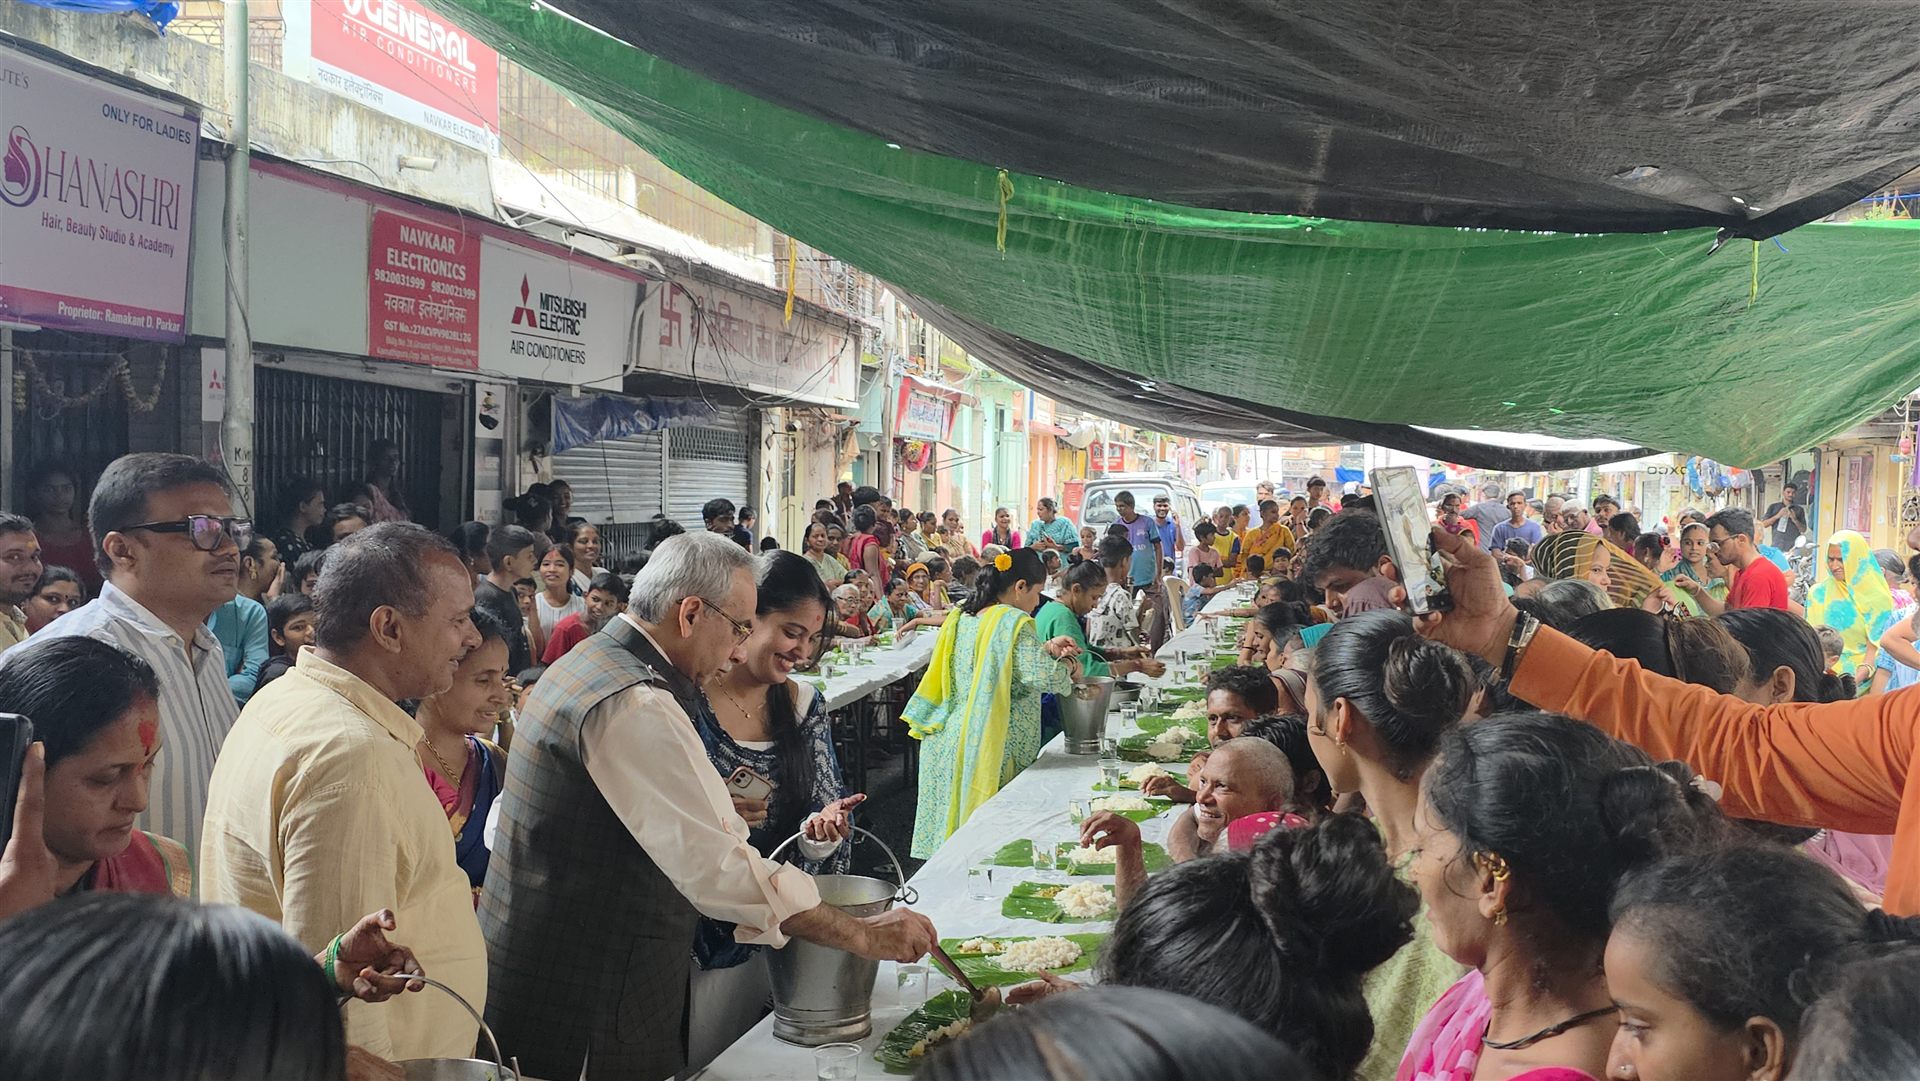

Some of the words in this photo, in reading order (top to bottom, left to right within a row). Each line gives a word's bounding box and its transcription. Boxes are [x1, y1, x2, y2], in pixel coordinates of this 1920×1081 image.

[342, 20, 369, 43] AIR
[376, 36, 477, 94] CONDITIONERS
[102, 103, 130, 124] ONLY
[132, 114, 153, 132] FOR
[156, 122, 191, 144] LADIES
[42, 211, 63, 233] Hair,
[66, 217, 97, 241] Beauty
[100, 225, 127, 245] Studio
[129, 232, 135, 247] &
[138, 234, 174, 258] Academy
[400, 224, 456, 255] NAVKAAR
[374, 268, 426, 290] 9820031999
[387, 247, 466, 281] ELECTRONICS
[58, 301, 103, 322] Proprietor:
[105, 309, 144, 328] Ramakant
[146, 316, 154, 329] D.
[156, 318, 181, 333] Parkar
[384, 293, 416, 316] नवकार
[540, 312, 581, 336] ELECTRIC
[510, 339, 525, 356] AIR
[526, 342, 586, 365] CONDITIONERS
